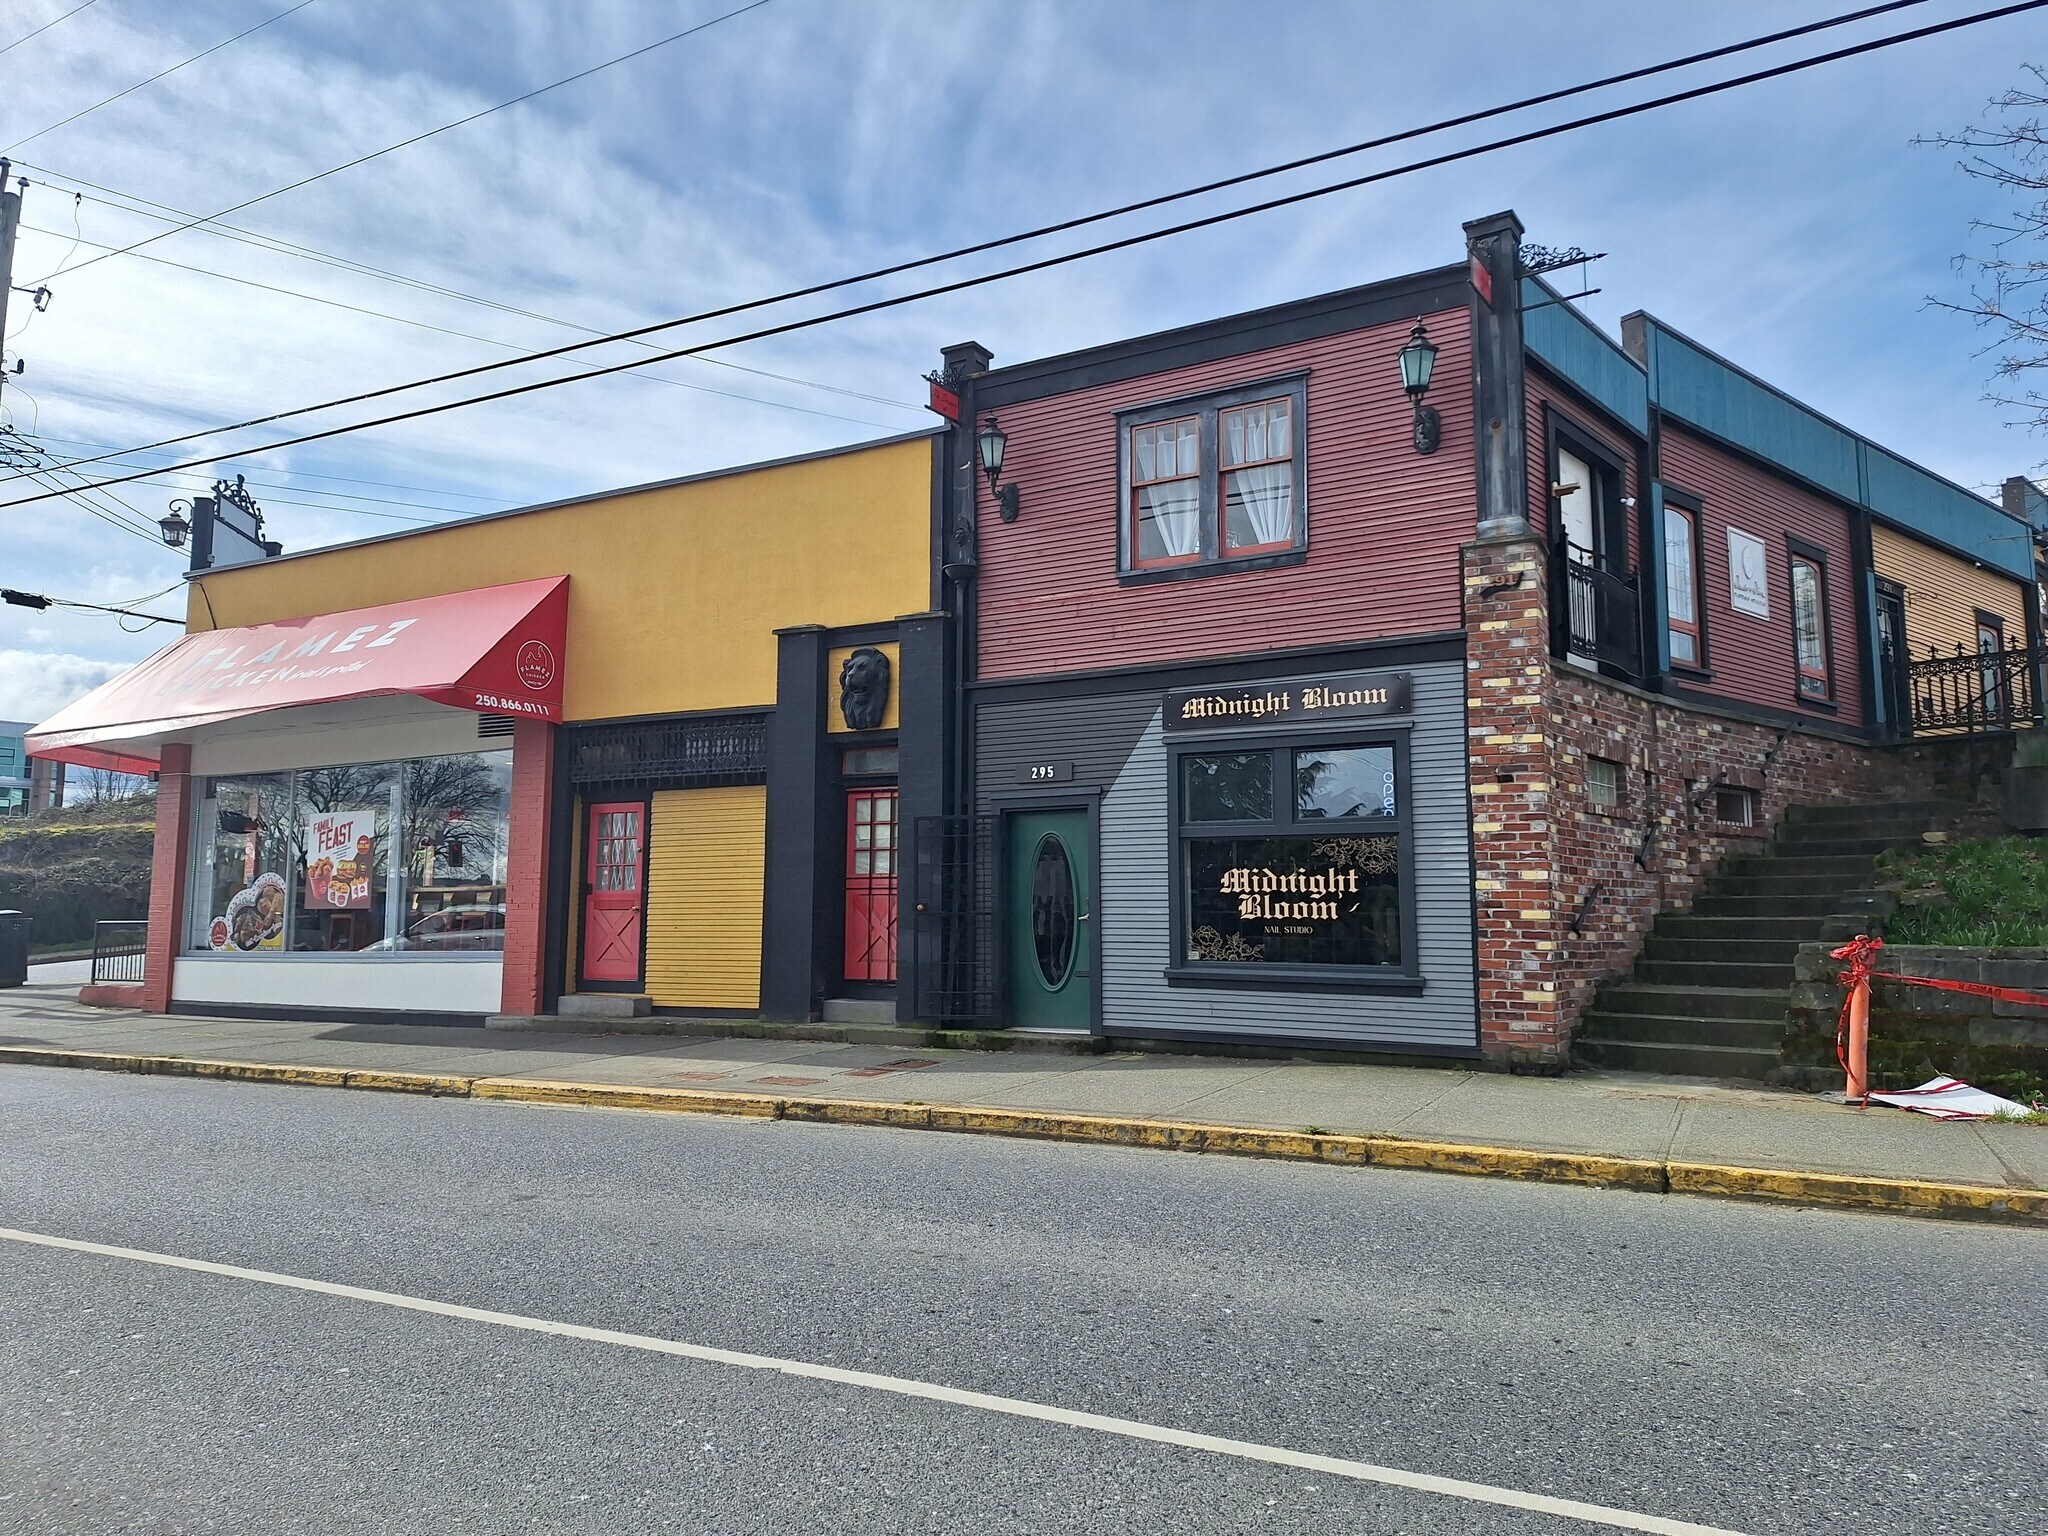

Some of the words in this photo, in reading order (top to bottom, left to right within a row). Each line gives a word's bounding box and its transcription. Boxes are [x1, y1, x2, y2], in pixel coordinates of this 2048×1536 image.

[184, 618, 419, 674] FLAMEZ
[520, 664, 551, 678] FLAMEZ
[475, 694, 550, 716] 250.866.0111
[1180, 691, 1291, 719] Midnight
[1301, 686, 1388, 710] Bloom
[1031, 765, 1054, 779] 295
[313, 816, 335, 835] FAMILY
[318, 820, 354, 854] FEAST
[1219, 867, 1360, 899] Midnight
[1238, 894, 1338, 920] Bloom
[1264, 925, 1282, 934] NAIL
[1284, 925, 1314, 935] STUDIO
